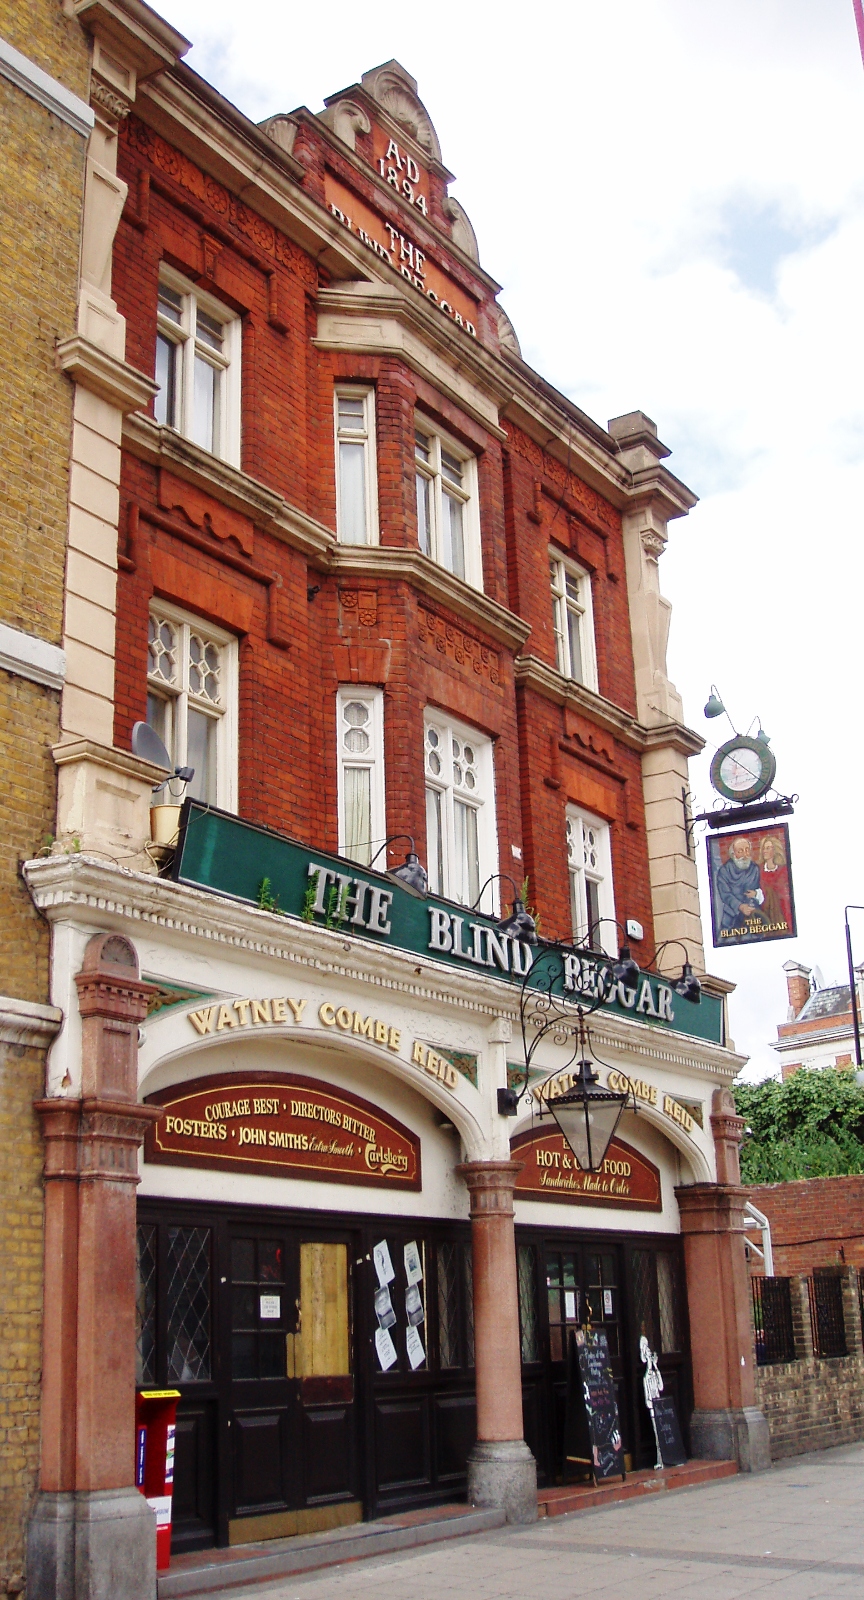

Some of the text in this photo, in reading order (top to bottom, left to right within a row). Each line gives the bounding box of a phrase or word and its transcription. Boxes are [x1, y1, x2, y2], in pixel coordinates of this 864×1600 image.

[379, 157, 429, 217] 1894
[385, 221, 427, 279] THE
[307, 861, 675, 1023] THE BLIND BEGGAR
[720, 921, 789, 938] BLIND BEGGAR
[744, 917, 763, 926] THE
[187, 996, 460, 1090] WATNEY COMBE REID
[204, 1098, 377, 1144] COURAGE BEST DIRECTORS BITTER
[533, 1069, 695, 1133] WATN COMBE REID
[165, 1115, 409, 1177] FOSTER'S JOHN SMITH'S Extra Smooth Carlsberg
[536, 1149, 561, 1168] HOT
[562, 1153, 573, 1169] &
[604, 1159, 631, 1177] FOOD
[582, 1174, 601, 1191] Made
[602, 1180, 610, 1193] to
[609, 1177, 631, 1195] Order
